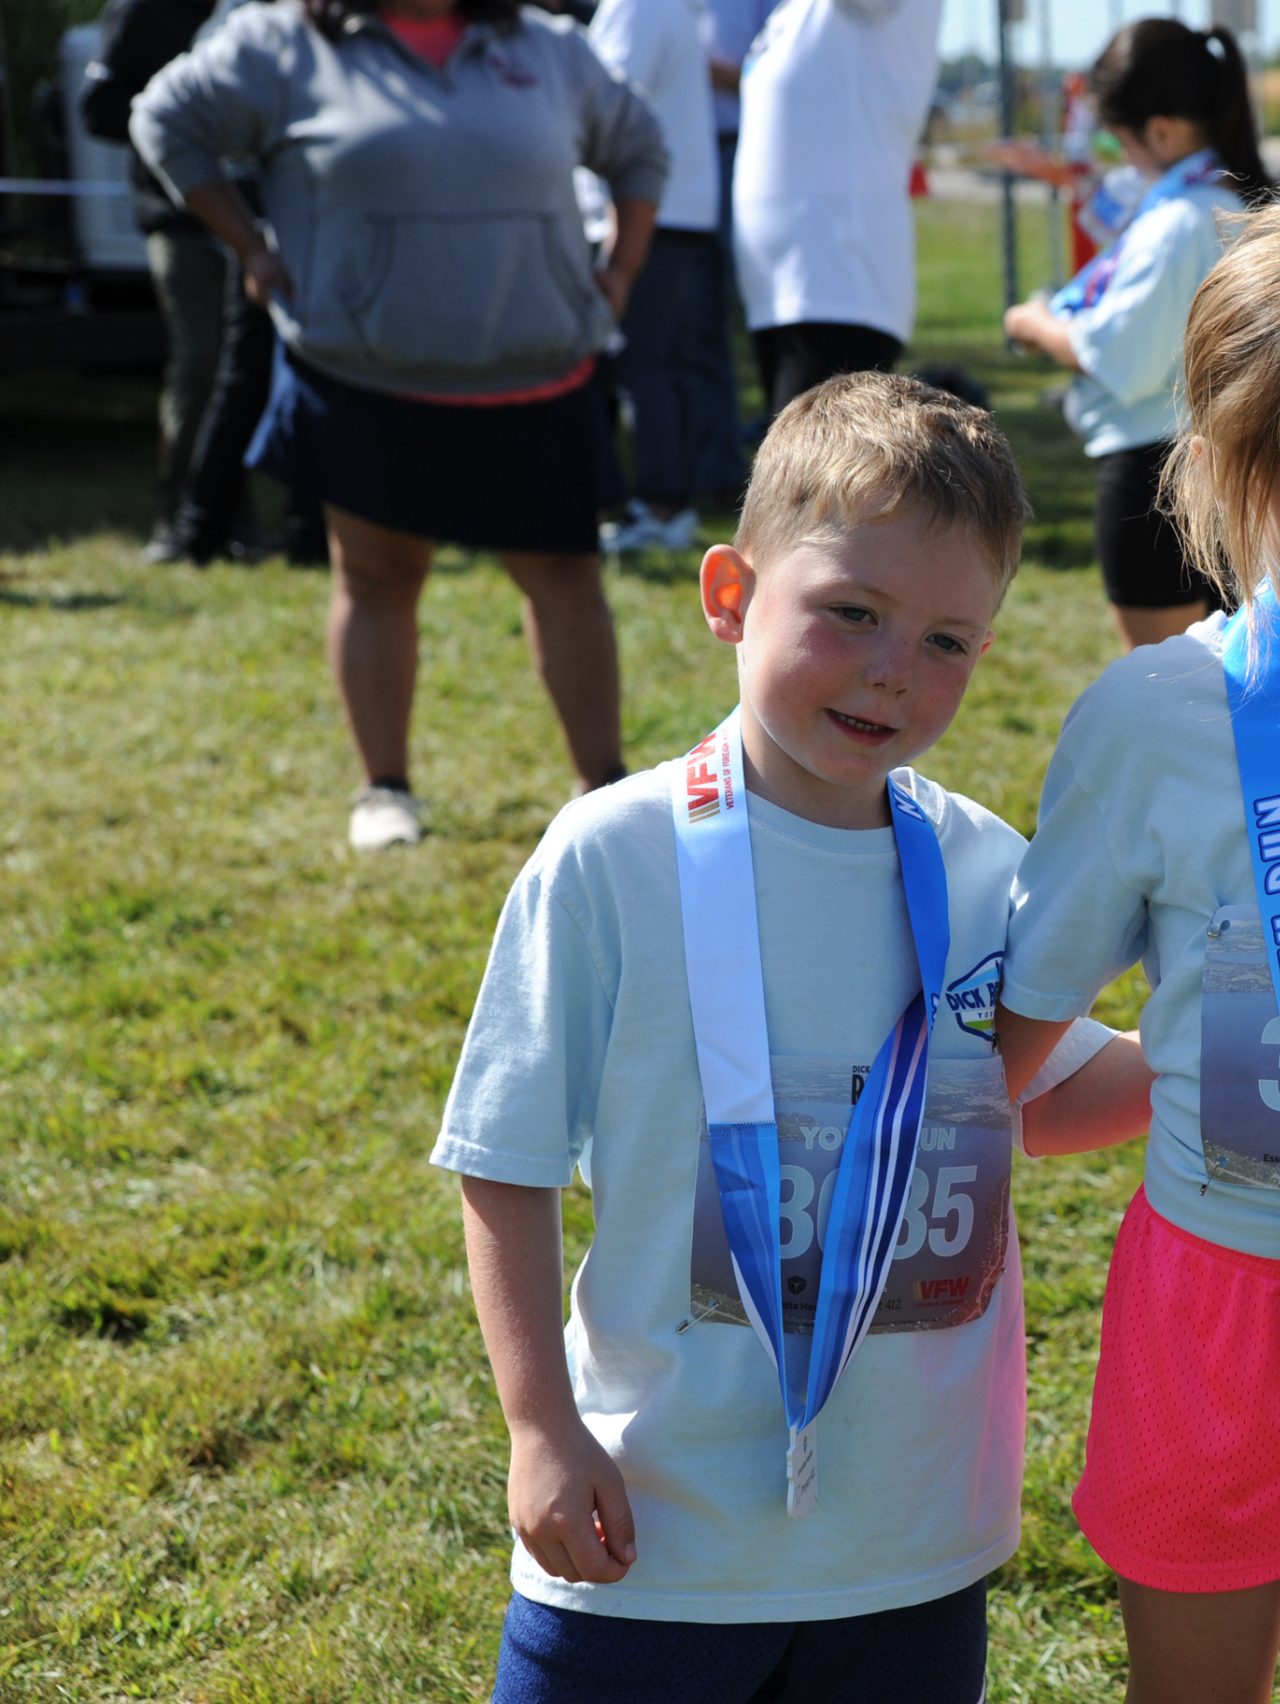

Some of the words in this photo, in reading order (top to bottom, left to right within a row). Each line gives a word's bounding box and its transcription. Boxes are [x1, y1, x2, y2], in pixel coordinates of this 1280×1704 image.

[945, 988, 986, 1012] DICK
[852, 1065, 870, 1074] DICK
[920, 1277, 970, 1300] VFW
